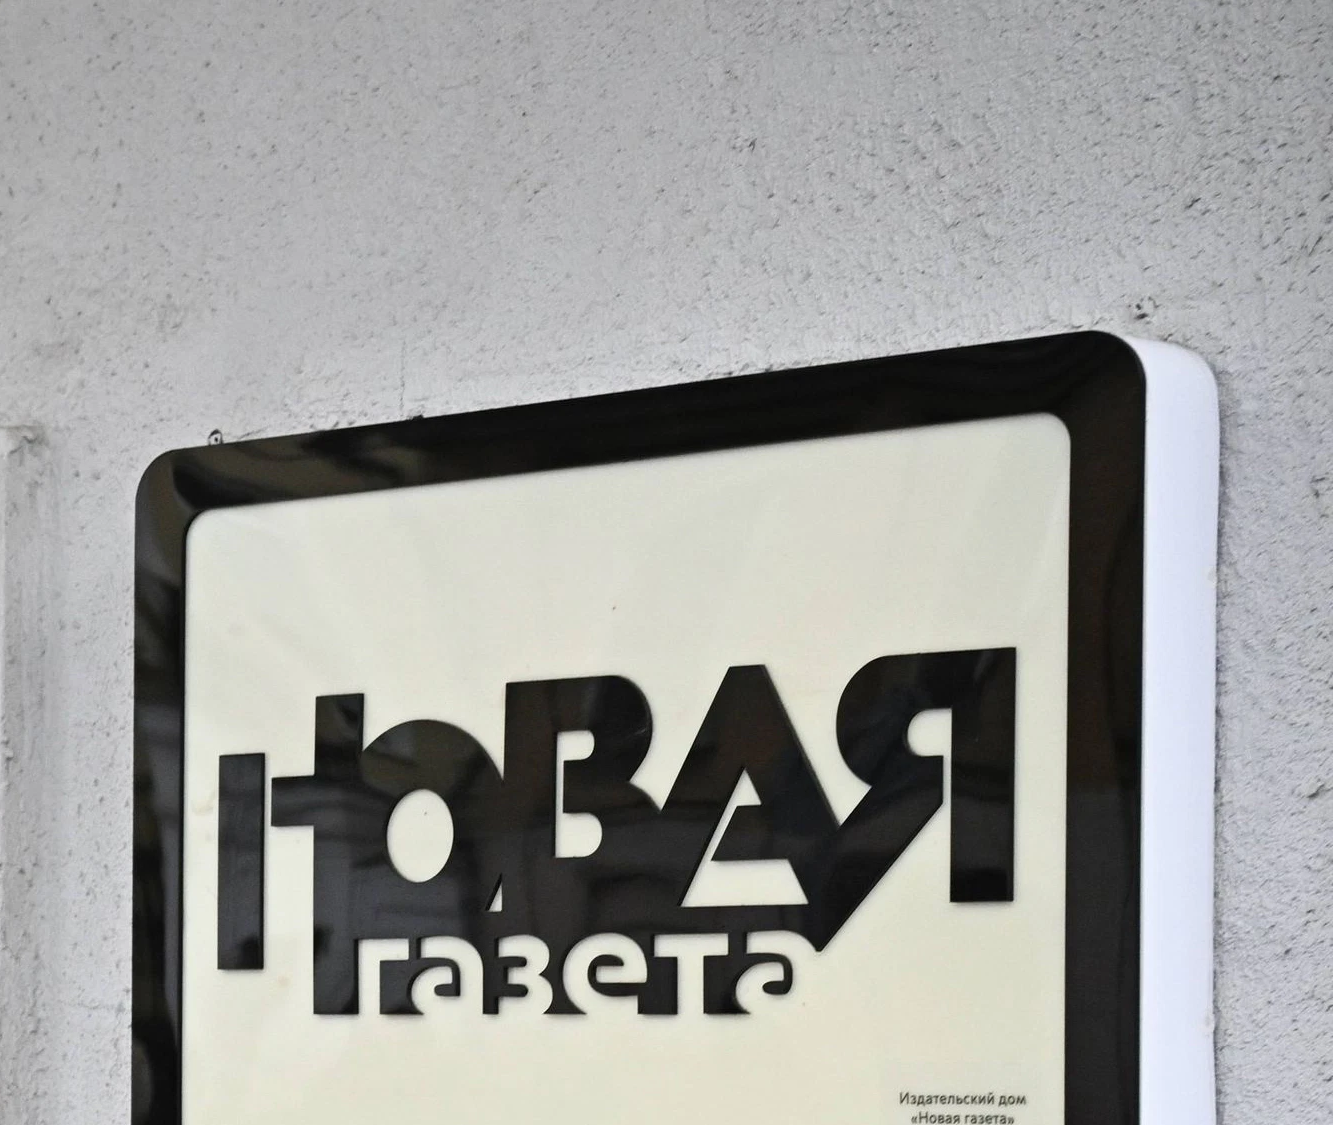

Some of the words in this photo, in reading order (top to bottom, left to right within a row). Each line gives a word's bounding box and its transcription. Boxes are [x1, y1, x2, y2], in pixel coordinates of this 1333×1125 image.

[217, 646, 1017, 1015] НОВАЯ
[355, 930, 820, 1016] газета
[899, 1091, 995, 1107] Издательский
[998, 1094, 1027, 1107] дом
[911, 1111, 961, 1125] «Новая
[964, 1113, 1015, 1125] газета»
